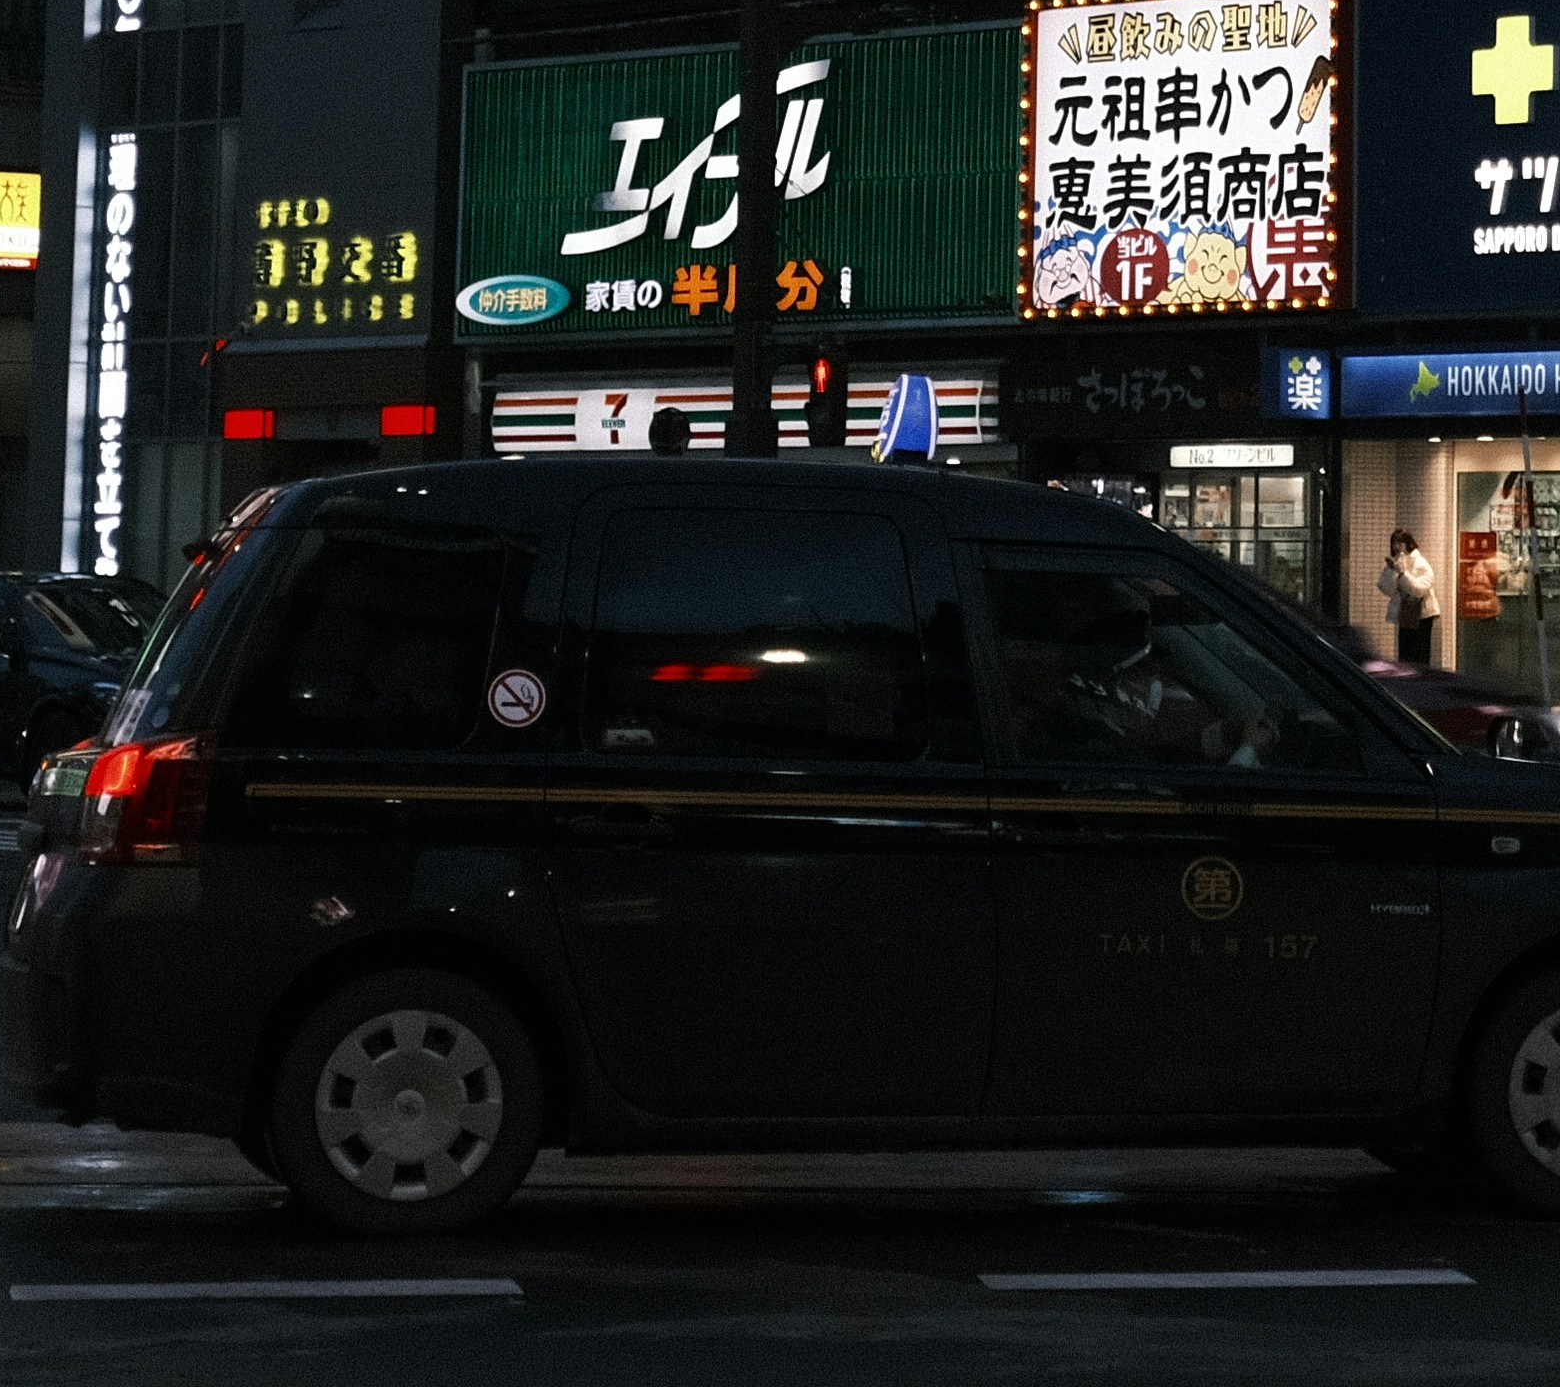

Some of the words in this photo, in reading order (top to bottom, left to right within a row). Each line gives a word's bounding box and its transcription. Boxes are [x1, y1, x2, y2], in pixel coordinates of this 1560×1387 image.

[1088, 1, 1287, 63] 昼飲みの聖地
[1048, 66, 1293, 146] 元祖串かつ
[1116, 235, 1157, 258] 当ビル
[1474, 225, 1549, 255] SAPPORO
[585, 279, 662, 313] 家賃の
[1116, 261, 1153, 301] 1F
[478, 287, 548, 314] 仲介手数料
[1077, 365, 1206, 414] さっぽろっこ
[1287, 377, 1322, 413] 薬
[1447, 363, 1546, 397] HOKKAIDO
[605, 393, 628, 444] 7
